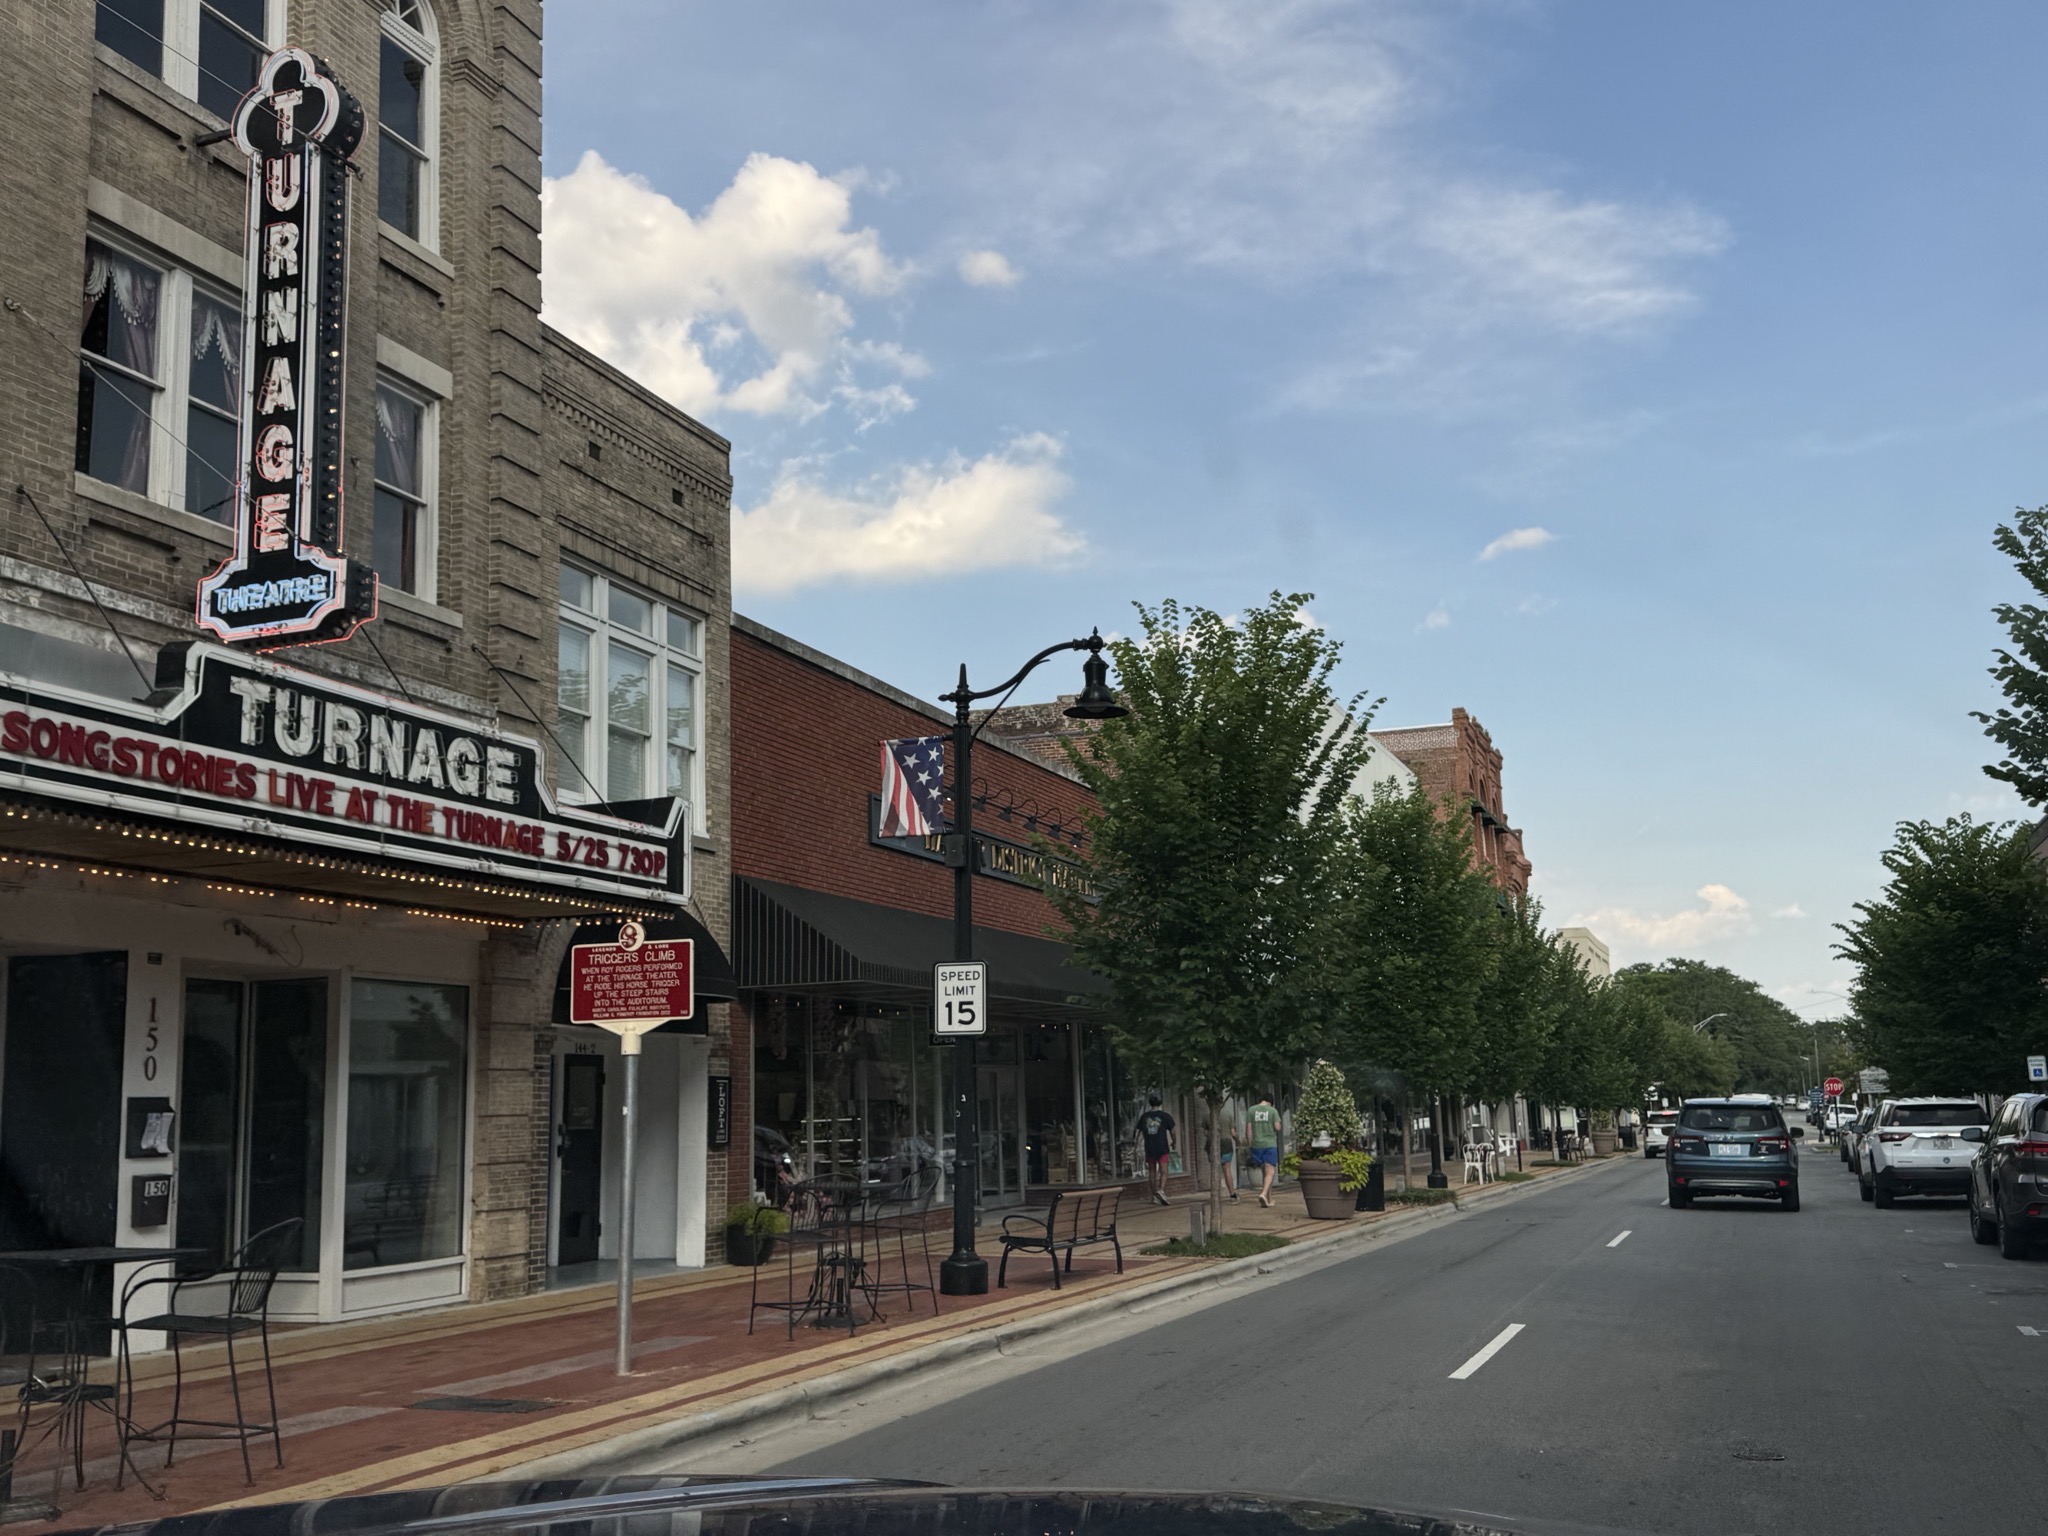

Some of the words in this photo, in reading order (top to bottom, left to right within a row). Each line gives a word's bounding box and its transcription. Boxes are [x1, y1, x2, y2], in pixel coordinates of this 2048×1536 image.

[254, 88, 303, 553] TURNAGE
[214, 574, 327, 615] THEATRE
[230, 675, 521, 806] TURNAGE
[1, 710, 257, 799] SONGSTORIES
[268, 768, 335, 817] LIVE
[345, 786, 379, 824] AT
[386, 794, 435, 834] THE
[442, 806, 545, 857] TURNAGE
[556, 831, 609, 868] 5/25
[618, 843, 665, 878] 730P
[588, 951, 639, 965] TRIGGER'S
[644, 949, 676, 962] CLIMB
[581, 967, 600, 975] WHEN
[601, 966, 614, 974] ROY
[615, 964, 642, 973] ROGERS
[643, 961, 683, 972] PERFORMED
[585, 975, 595, 983] AT
[597, 974, 610, 982] THE
[612, 972, 644, 982] TURNAGE
[940, 970, 981, 982] SPEED
[583, 983, 593, 991] HE
[594, 982, 612, 990] RODE
[613, 981, 625, 990] HIS
[626, 980, 648, 989] HORSE
[651, 978, 680, 988] TRIGGER
[944, 985, 976, 996] LIMIT
[593, 990, 604, 999] UP
[605, 990, 619, 998] THE
[621, 988, 643, 997] STEEP
[645, 987, 669, 996] STAIRS
[594, 999, 610, 1007] INTO
[611, 998, 626, 1006] THE
[945, 1000, 976, 1026] 15
[143, 998, 159, 1081] 150
[932, 1036, 956, 1044] OPEN
[1825, 1083, 1843, 1091] STOP
[718, 1086, 726, 1128] LOFT
[147, 1181, 168, 1196] 150
